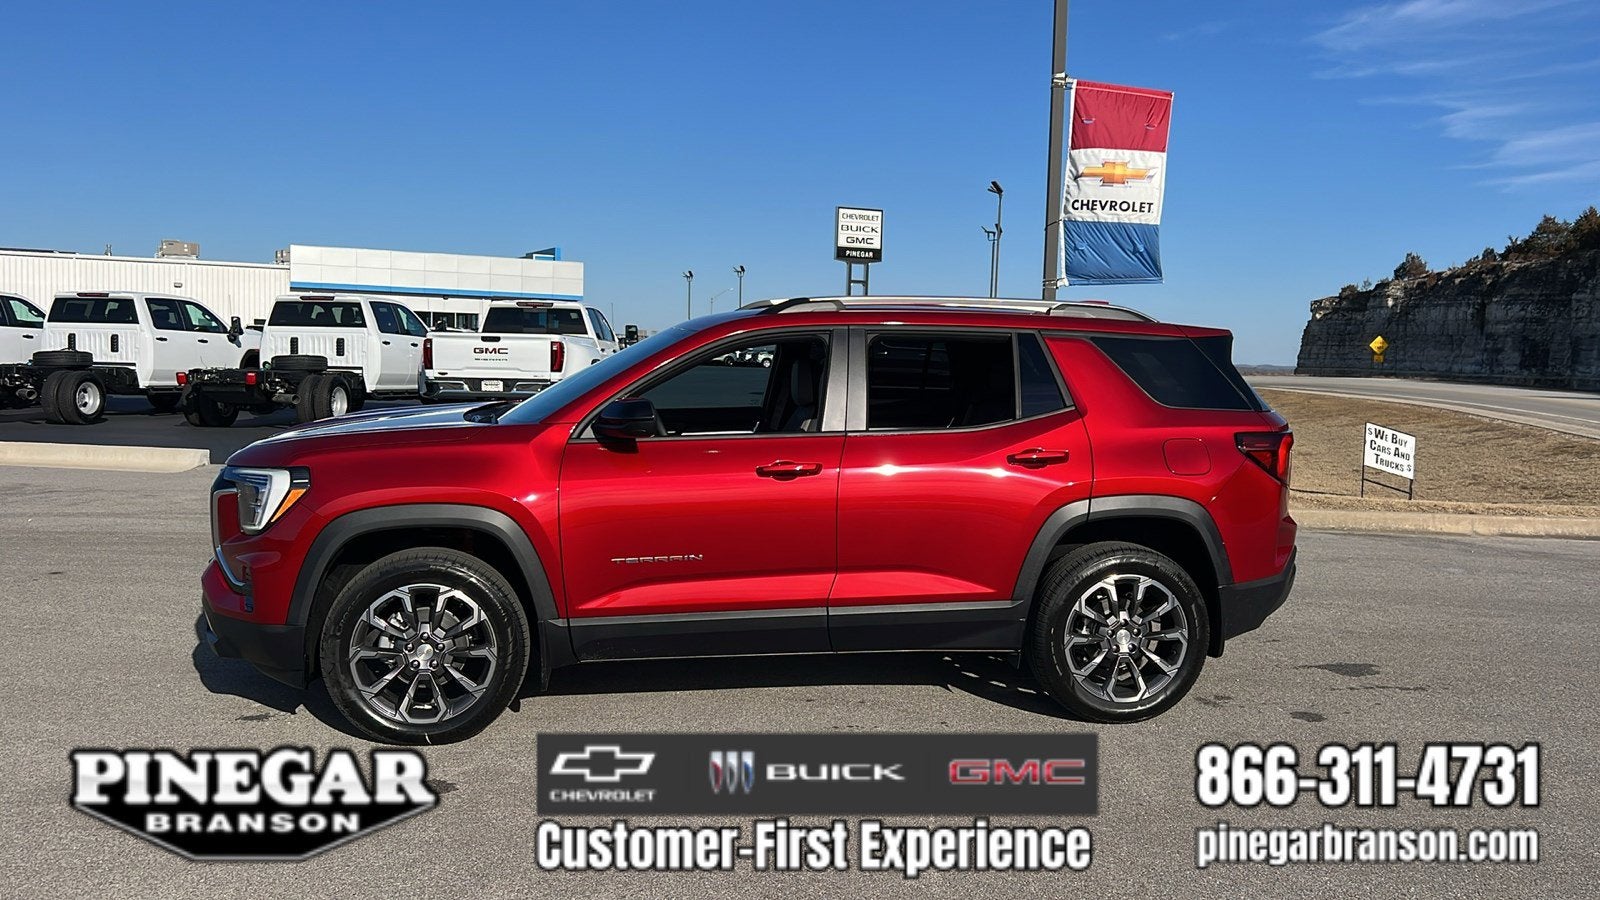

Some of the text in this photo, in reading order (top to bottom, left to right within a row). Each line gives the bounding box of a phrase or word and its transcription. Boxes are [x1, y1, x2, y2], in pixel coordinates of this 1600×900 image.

[1071, 199, 1154, 214] CHEVROLET
[841, 212, 880, 222] CHEVROLET
[840, 224, 879, 234] BUICK
[845, 236, 874, 245] GMC
[845, 250, 874, 258] PINEGAR
[473, 347, 509, 355] GMC
[611, 554, 703, 564] TERRAIN
